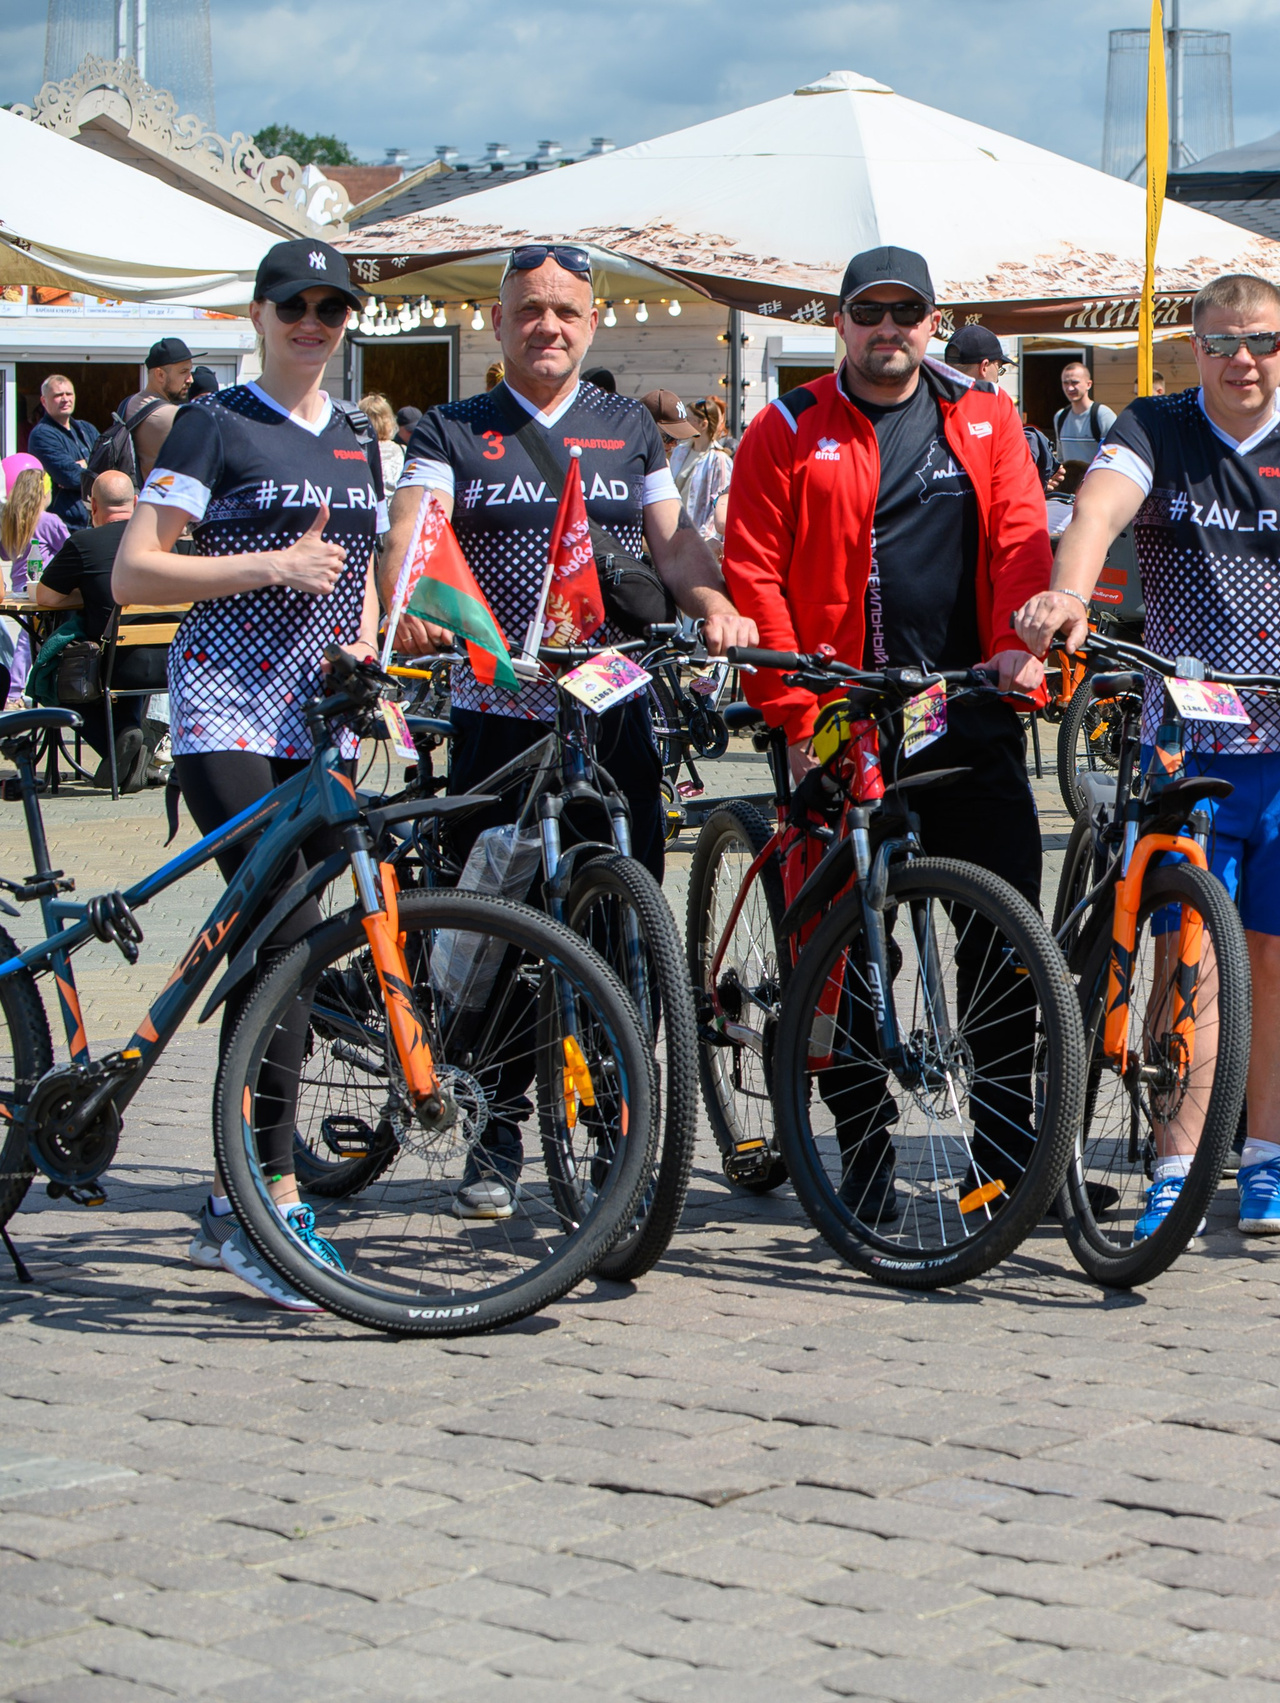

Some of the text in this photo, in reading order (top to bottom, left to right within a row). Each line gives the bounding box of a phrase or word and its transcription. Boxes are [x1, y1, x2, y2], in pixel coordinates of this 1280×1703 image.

[482, 430, 506, 460] 3
[563, 437, 625, 450] РЕМАВТОДОР
[927, 1257, 946, 1268] ALL
[408, 1304, 480, 1319] KENDA
